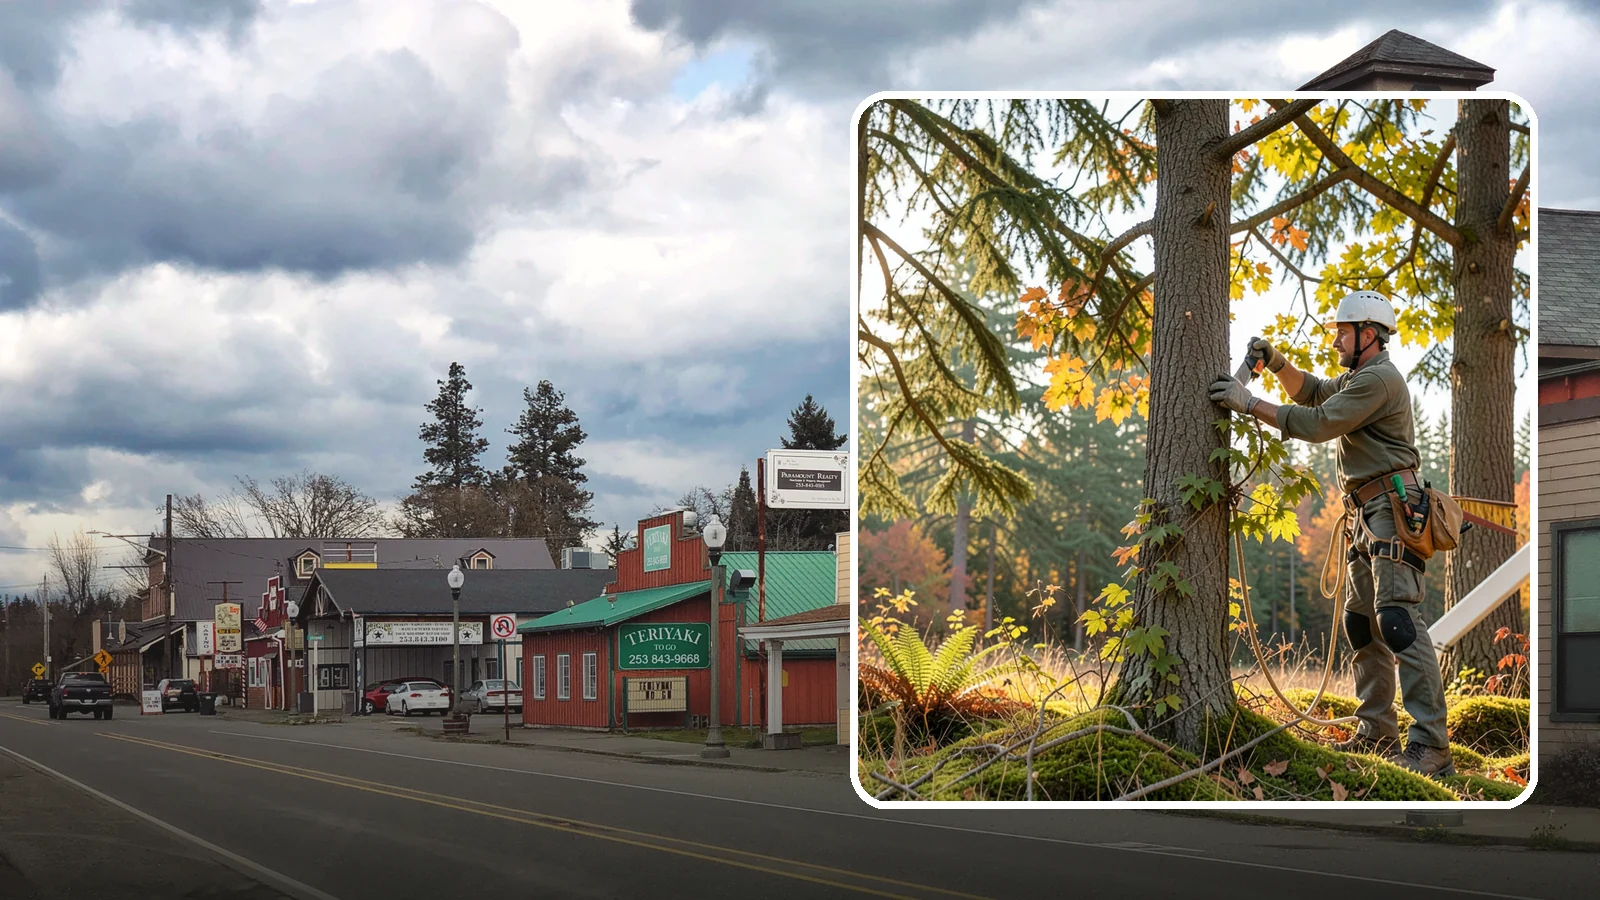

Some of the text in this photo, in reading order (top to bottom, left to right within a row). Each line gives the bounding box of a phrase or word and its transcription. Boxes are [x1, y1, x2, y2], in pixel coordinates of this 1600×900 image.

[781, 471, 839, 480] PARAMOUNT REALTY
[625, 627, 702, 646] TERIYAKI
[628, 653, 700, 664] 253 843-9668
